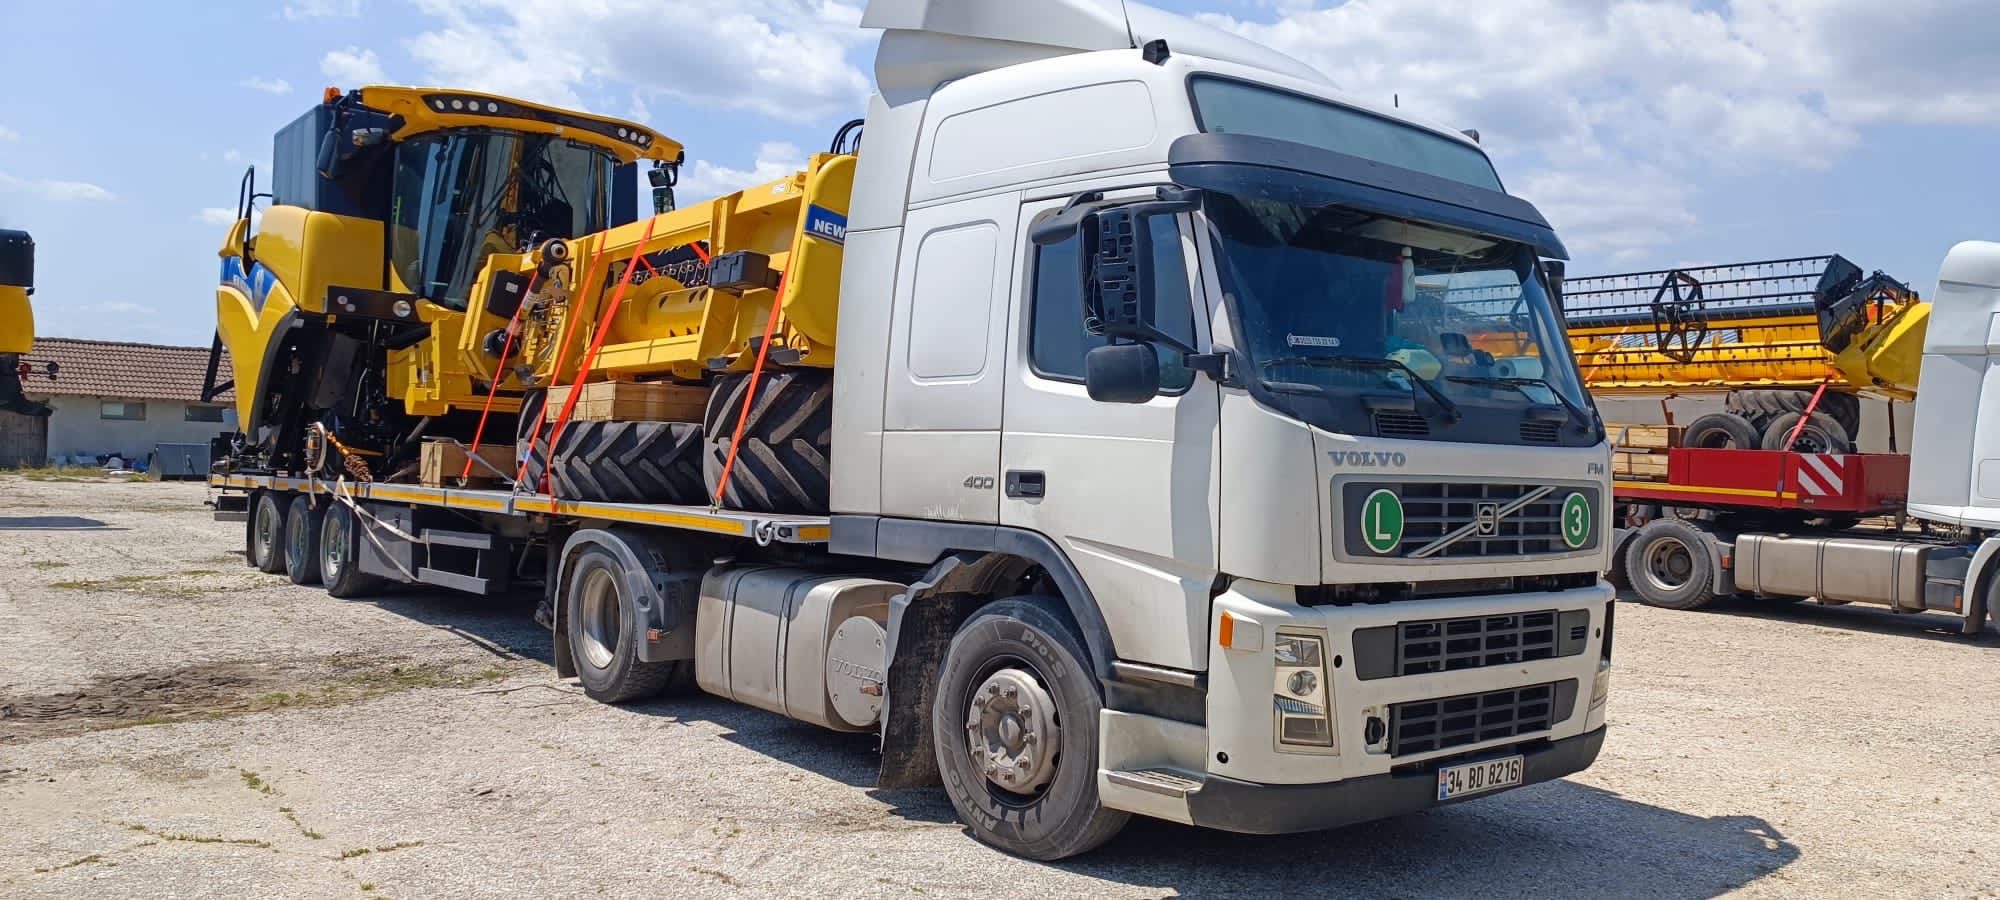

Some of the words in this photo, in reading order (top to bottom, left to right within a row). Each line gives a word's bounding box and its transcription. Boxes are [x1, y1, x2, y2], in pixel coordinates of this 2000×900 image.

[814, 218, 846, 239] NEW
[1328, 451, 1406, 467] VOLVO
[1588, 462, 1604, 475] FM
[963, 475, 994, 489] 400
[1375, 502, 1392, 540] L
[1571, 504, 1582, 537] 3
[1447, 769, 1463, 794] 34
[1468, 765, 1484, 789] BD
[1488, 760, 1519, 785] 8216
